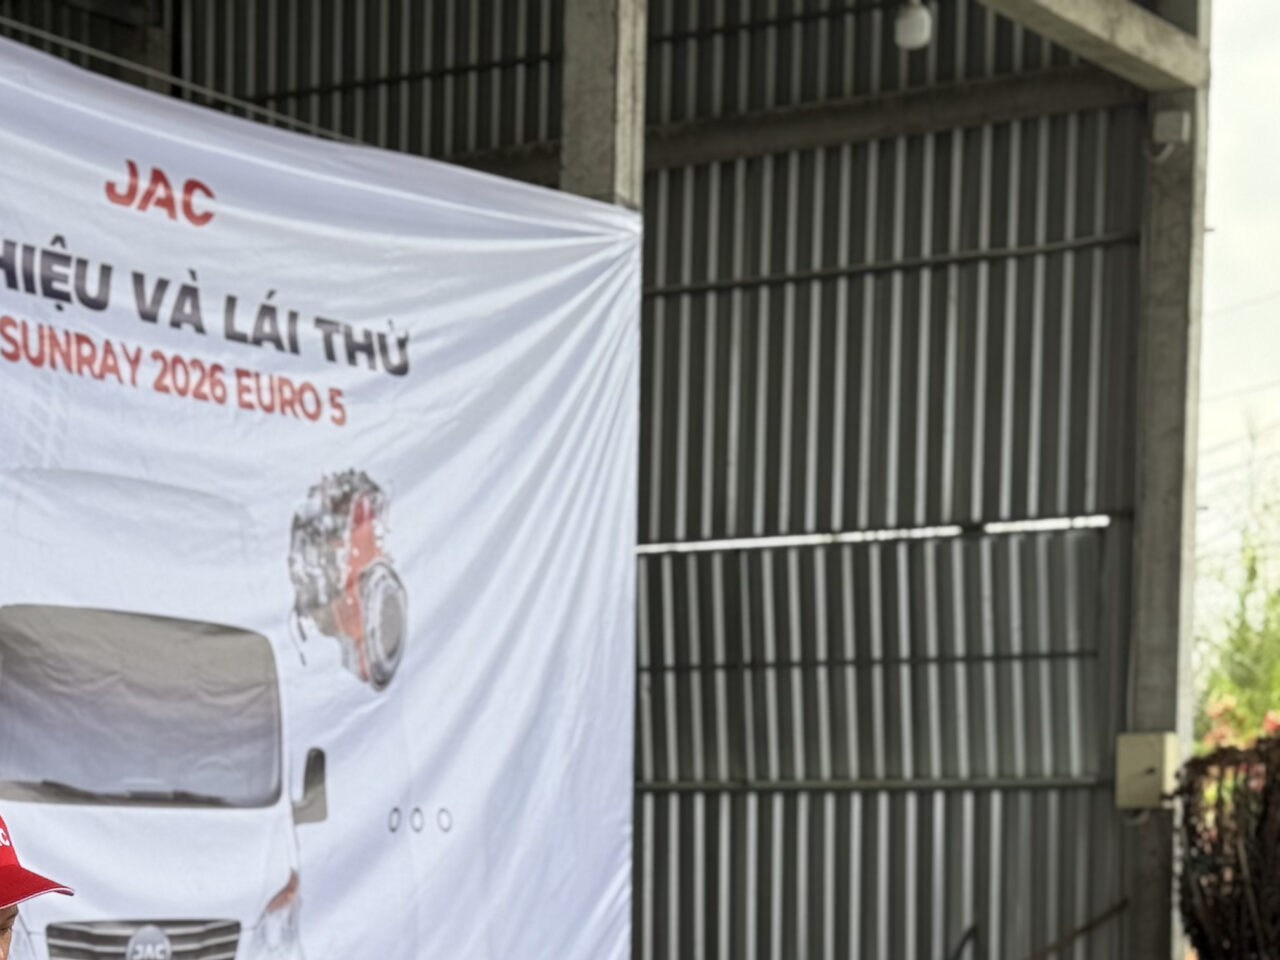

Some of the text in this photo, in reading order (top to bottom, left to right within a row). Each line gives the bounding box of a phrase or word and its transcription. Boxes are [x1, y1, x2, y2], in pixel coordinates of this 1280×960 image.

[105, 159, 216, 226] JAC
[132, 269, 206, 336] VÀ
[223, 289, 301, 355] LÁI
[0, 314, 142, 388] SUNRAY
[151, 350, 227, 405] 2026
[234, 368, 322, 422] EURO
[328, 388, 347, 426] 5
